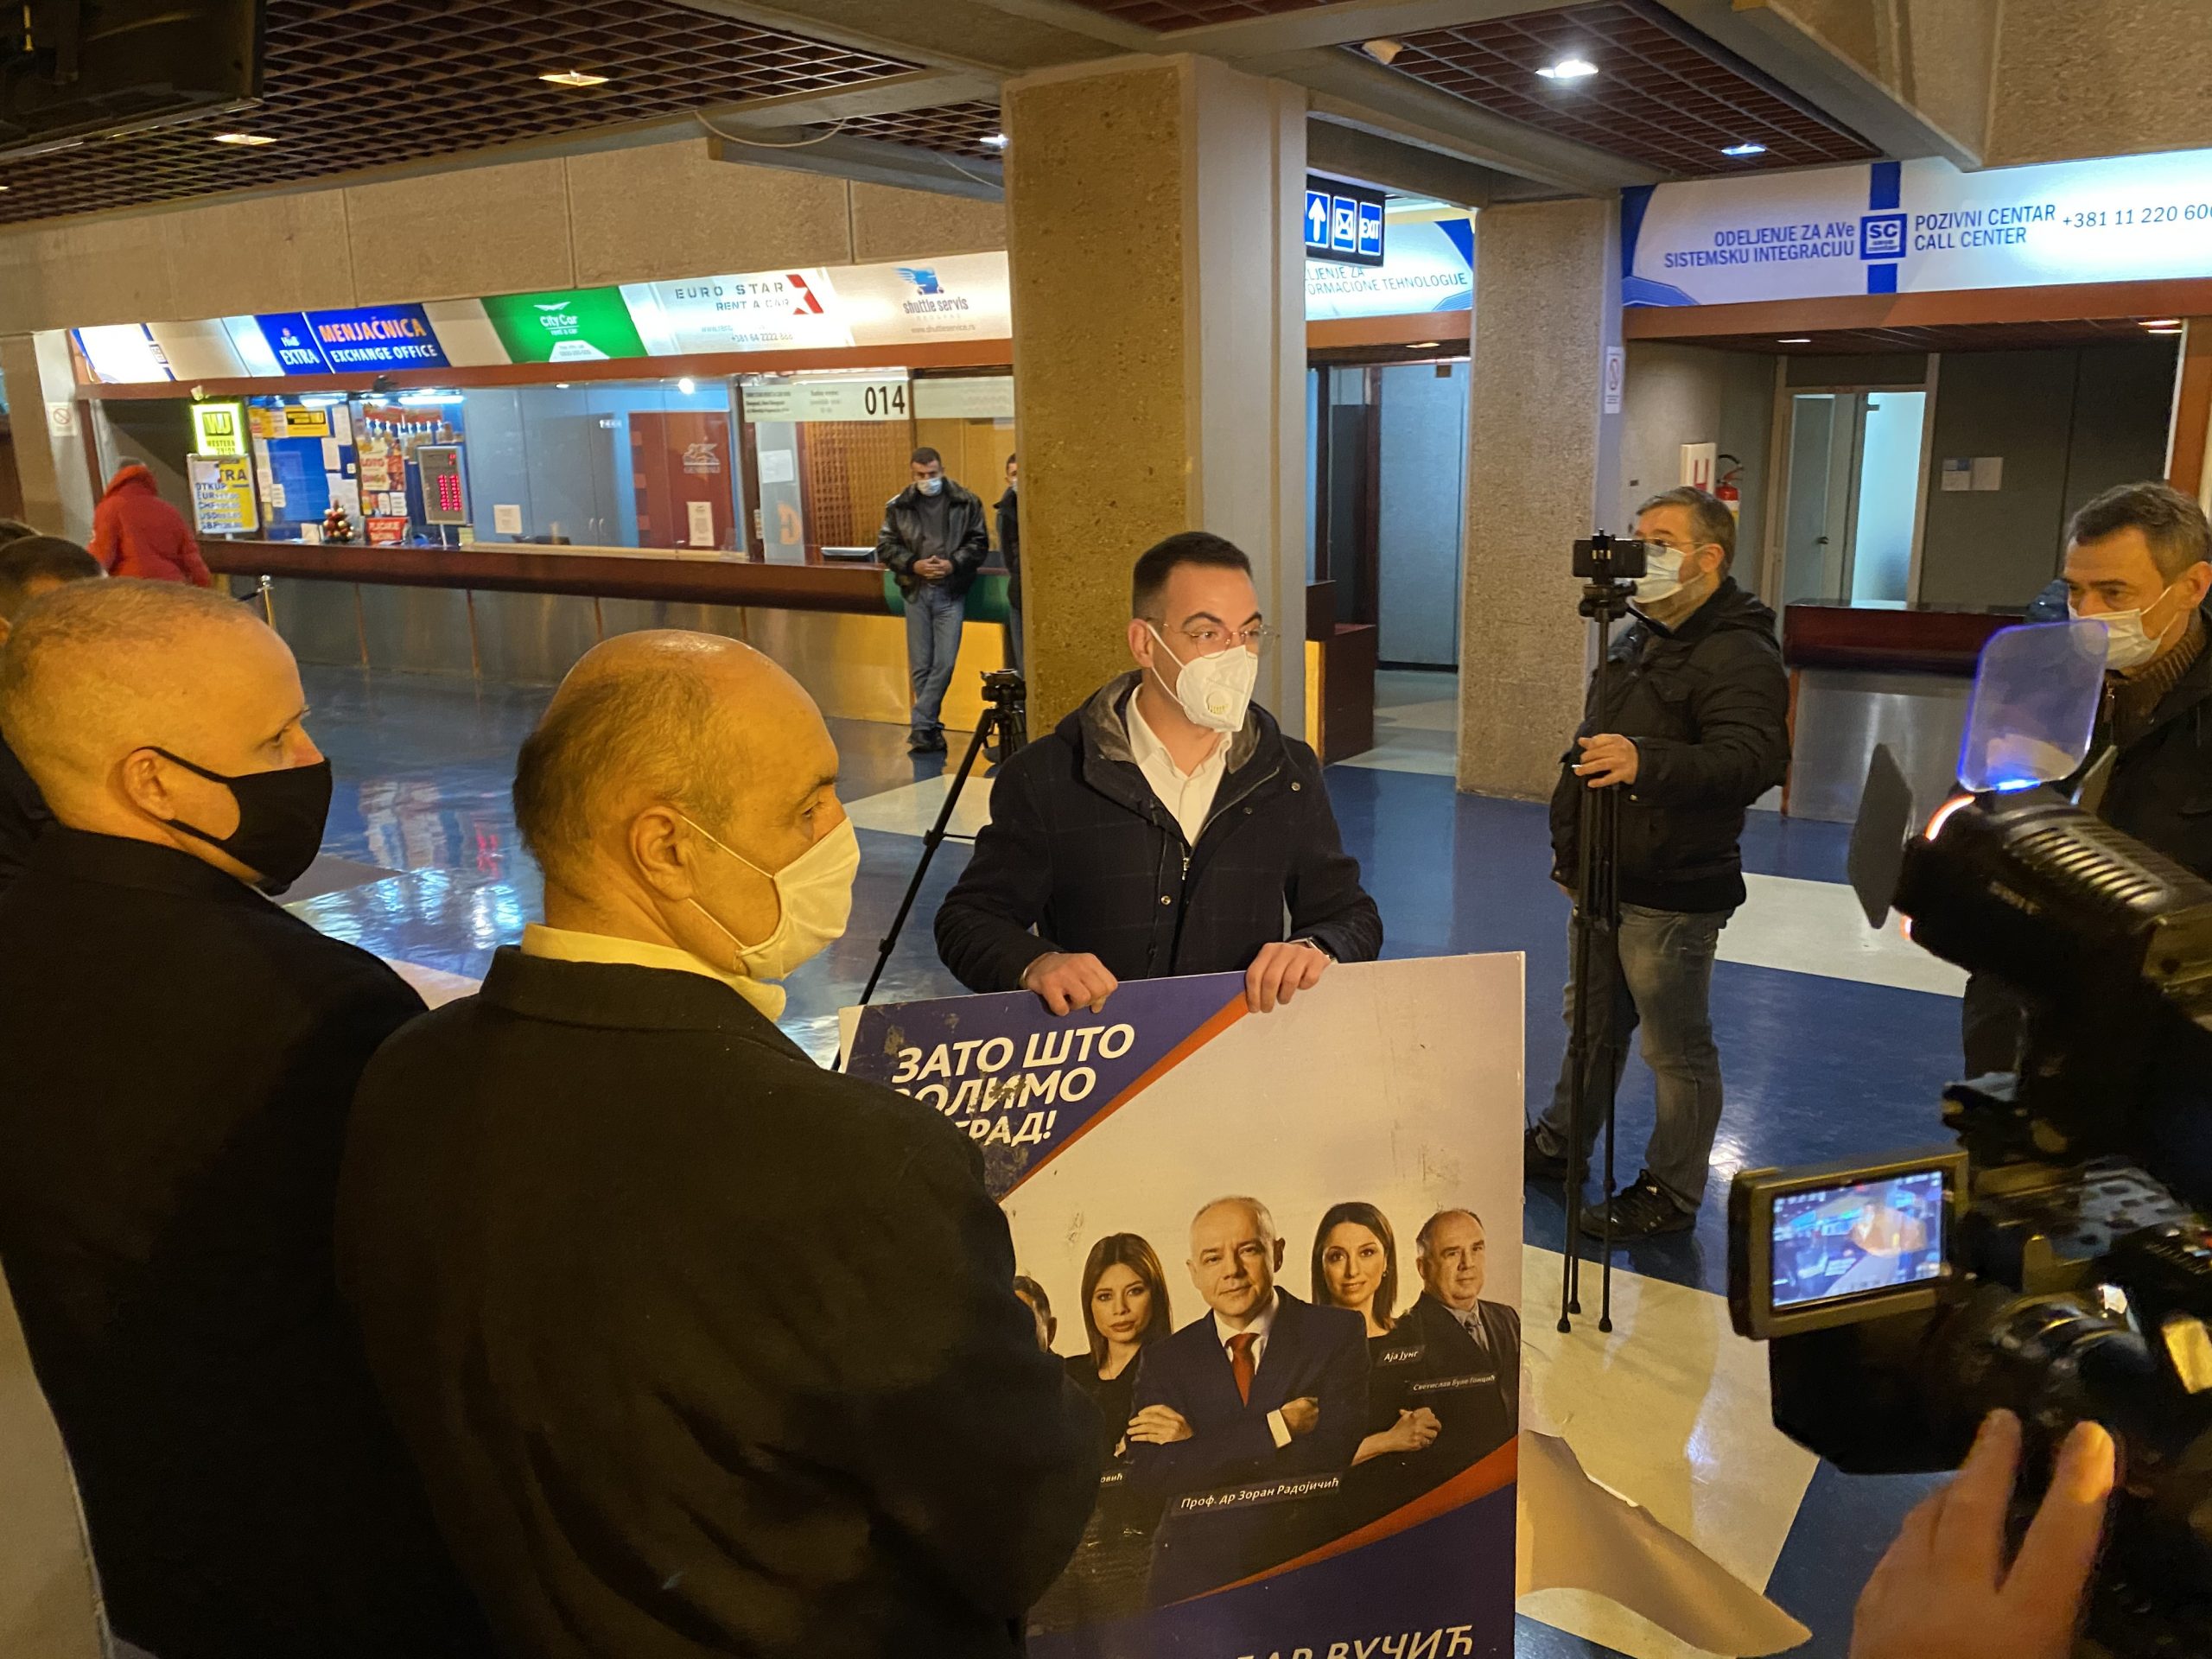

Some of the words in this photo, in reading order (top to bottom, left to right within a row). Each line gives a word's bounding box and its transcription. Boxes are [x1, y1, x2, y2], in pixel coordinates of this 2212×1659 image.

[1915, 210, 1982, 232] POZIVNI
[1988, 204, 2056, 226] CENTAR
[2063, 211, 2107, 228] +381
[2114, 209, 2134, 226] 11
[2141, 206, 2178, 224] 220
[2184, 203, 2212, 220] 60
[1360, 217, 1380, 240] EXIT
[1714, 226, 1796, 247] ODELJENJE
[1801, 225, 1821, 240] ZA
[1825, 222, 1855, 238] AVe
[1869, 223, 1897, 239] SC
[1914, 232, 1955, 251] CALL
[1961, 227, 2026, 248] CENTER
[1664, 248, 1750, 268] SISTEMSKU
[1754, 240, 1854, 263] INTEGRACIJU
[675, 286, 723, 300] EURO
[735, 283, 784, 296] STAR
[1306, 279, 1380, 296] ORMACIONE
[1382, 272, 1467, 289] TEHNOLOGIJE
[715, 300, 747, 311] RENT
[753, 300, 760, 308] A
[903, 298, 937, 314] shuttle
[937, 296, 969, 312] servis
[318, 316, 427, 343] MENJAČNICA
[279, 348, 320, 365] EXTRA
[329, 346, 392, 364] EXCHANGE
[392, 344, 438, 359] OFFICE
[864, 385, 906, 415] 014
[892, 1037, 1014, 1084] ЗАТО
[1022, 1023, 1135, 1069] ШТО
[894, 1066, 1096, 1116] ОЛИМО
[955, 1109, 1057, 1147] РАД!
[1180, 1495, 1217, 1510] Проф.
[1219, 1493, 1236, 1505] др
[1237, 1489, 1274, 1502] Зоран
[1276, 1477, 1339, 1496] Радојичић
